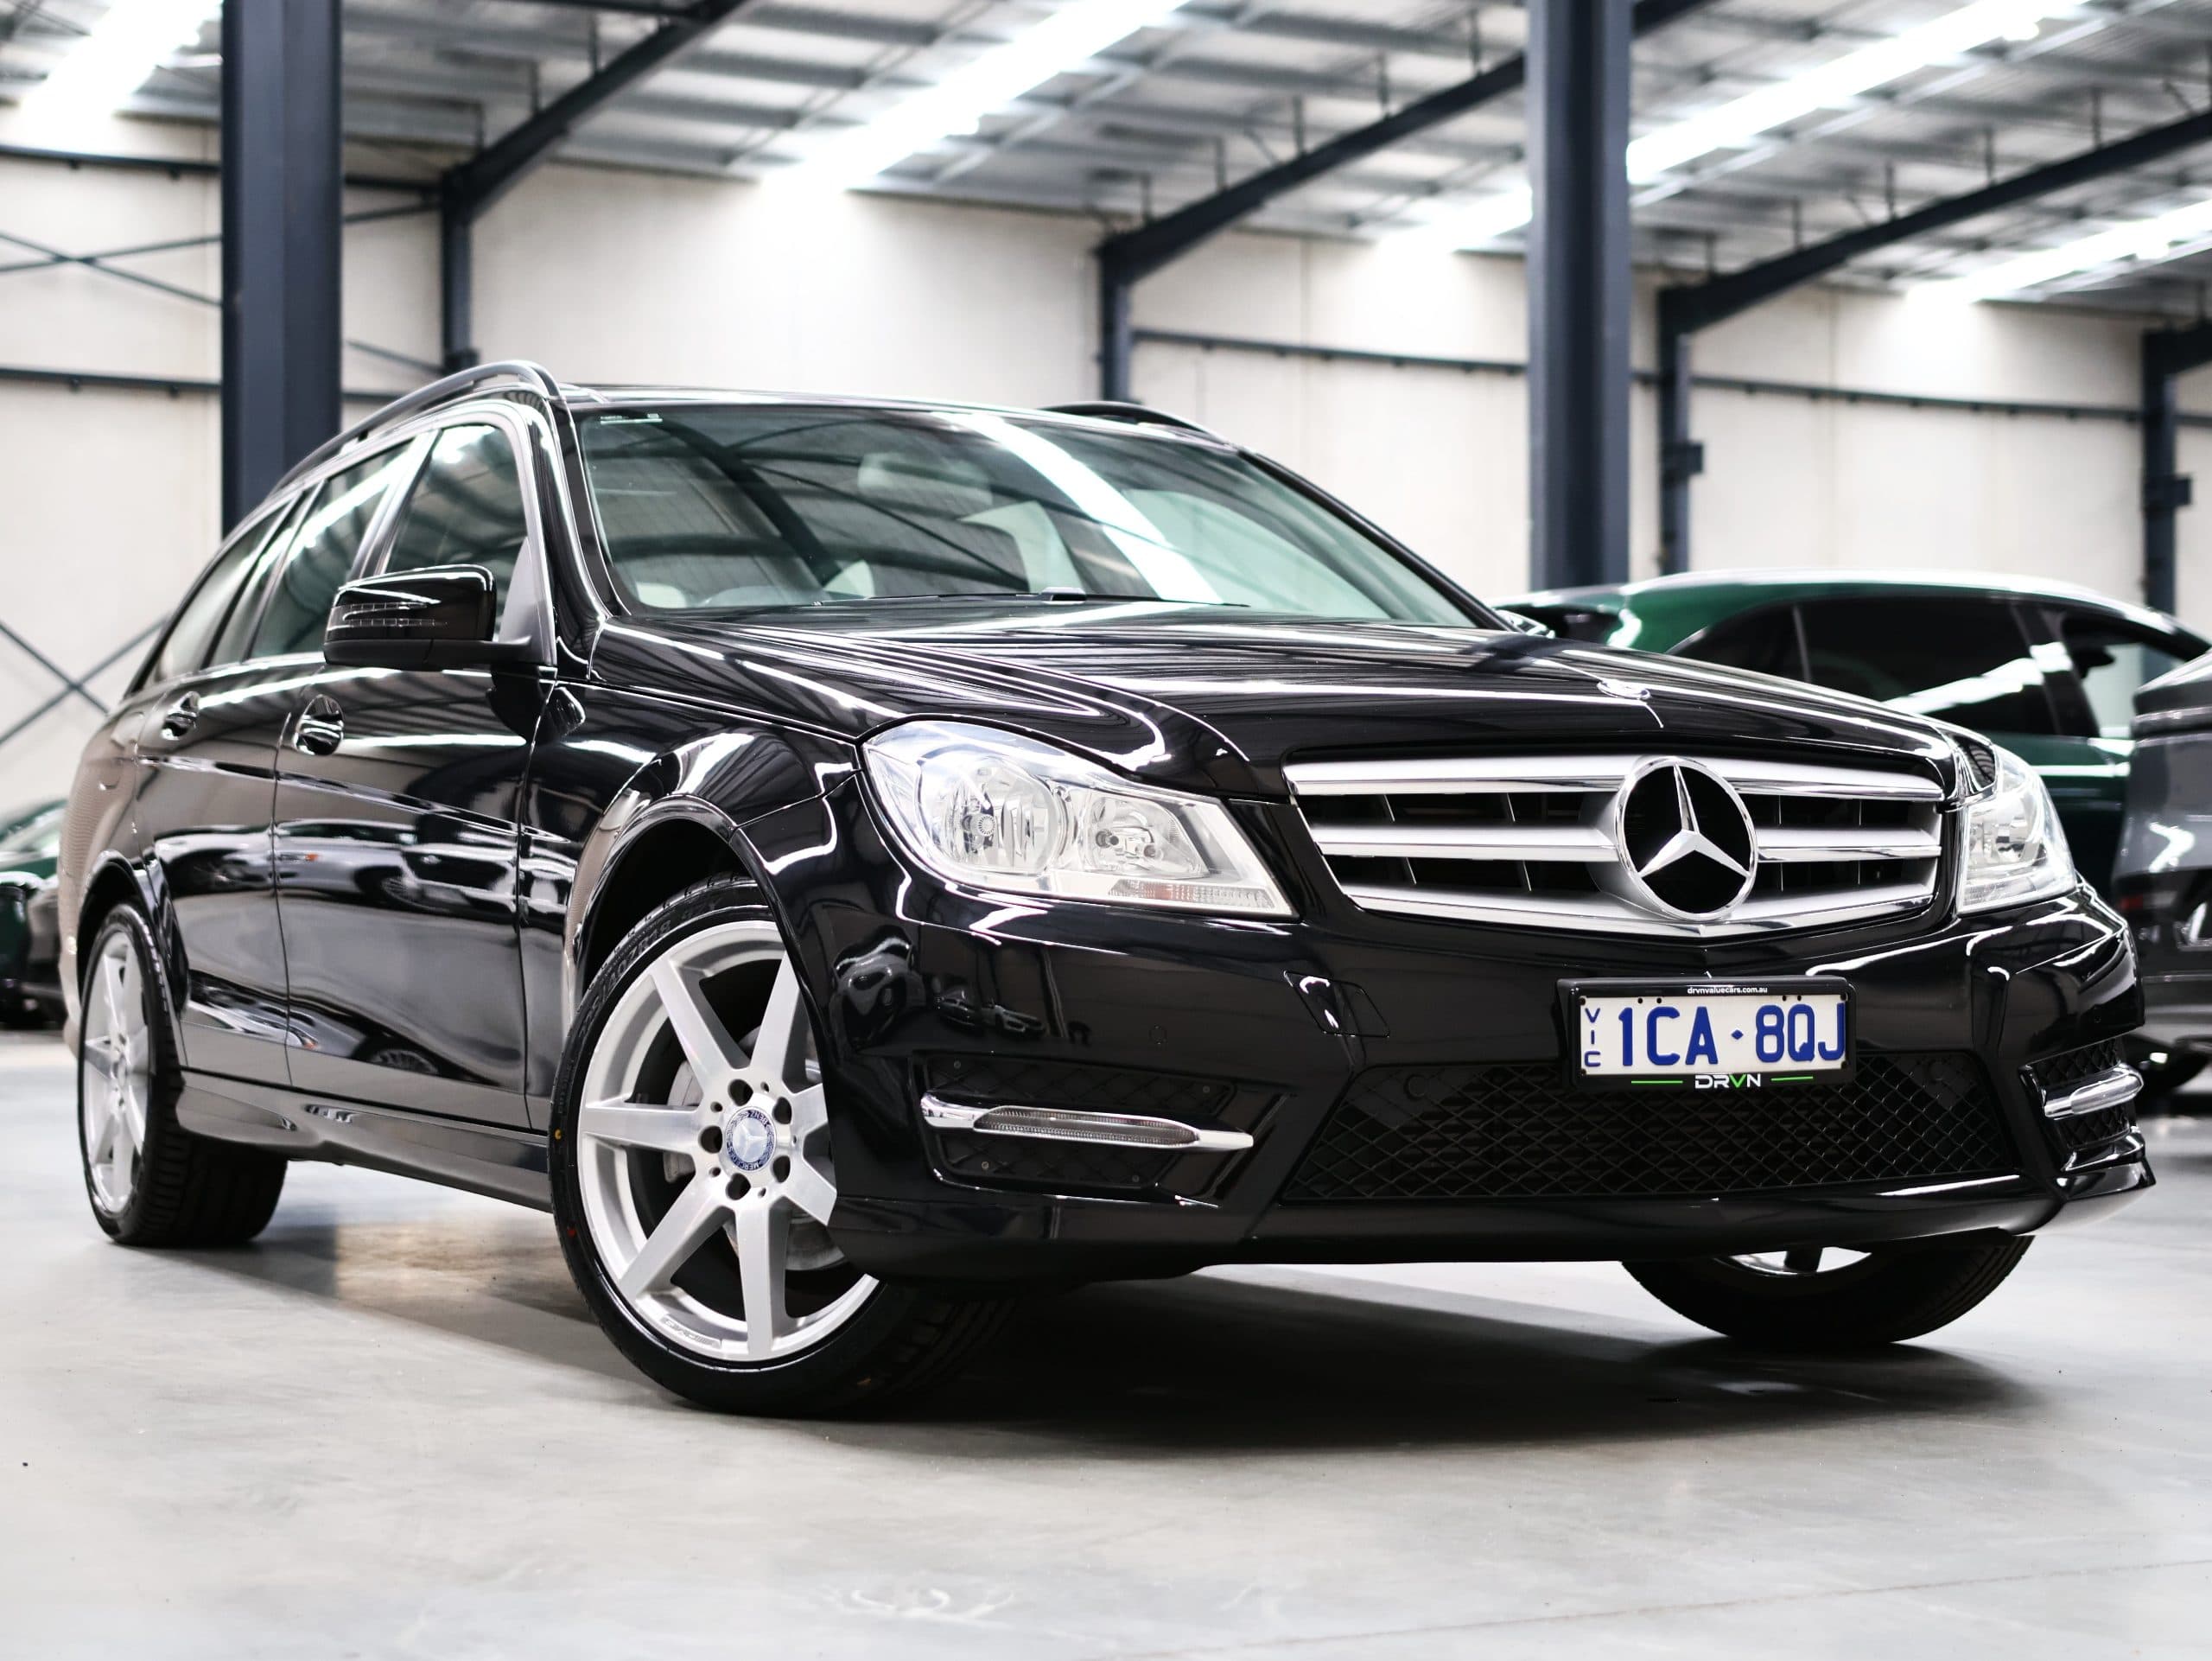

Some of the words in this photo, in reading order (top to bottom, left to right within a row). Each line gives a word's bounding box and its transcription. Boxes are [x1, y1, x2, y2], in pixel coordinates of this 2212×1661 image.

[1687, 986, 1768, 995] drvnvaluecars.com.au
[1584, 1007, 1601, 1067] VIC
[1694, 1073, 1761, 1089] DRVN
